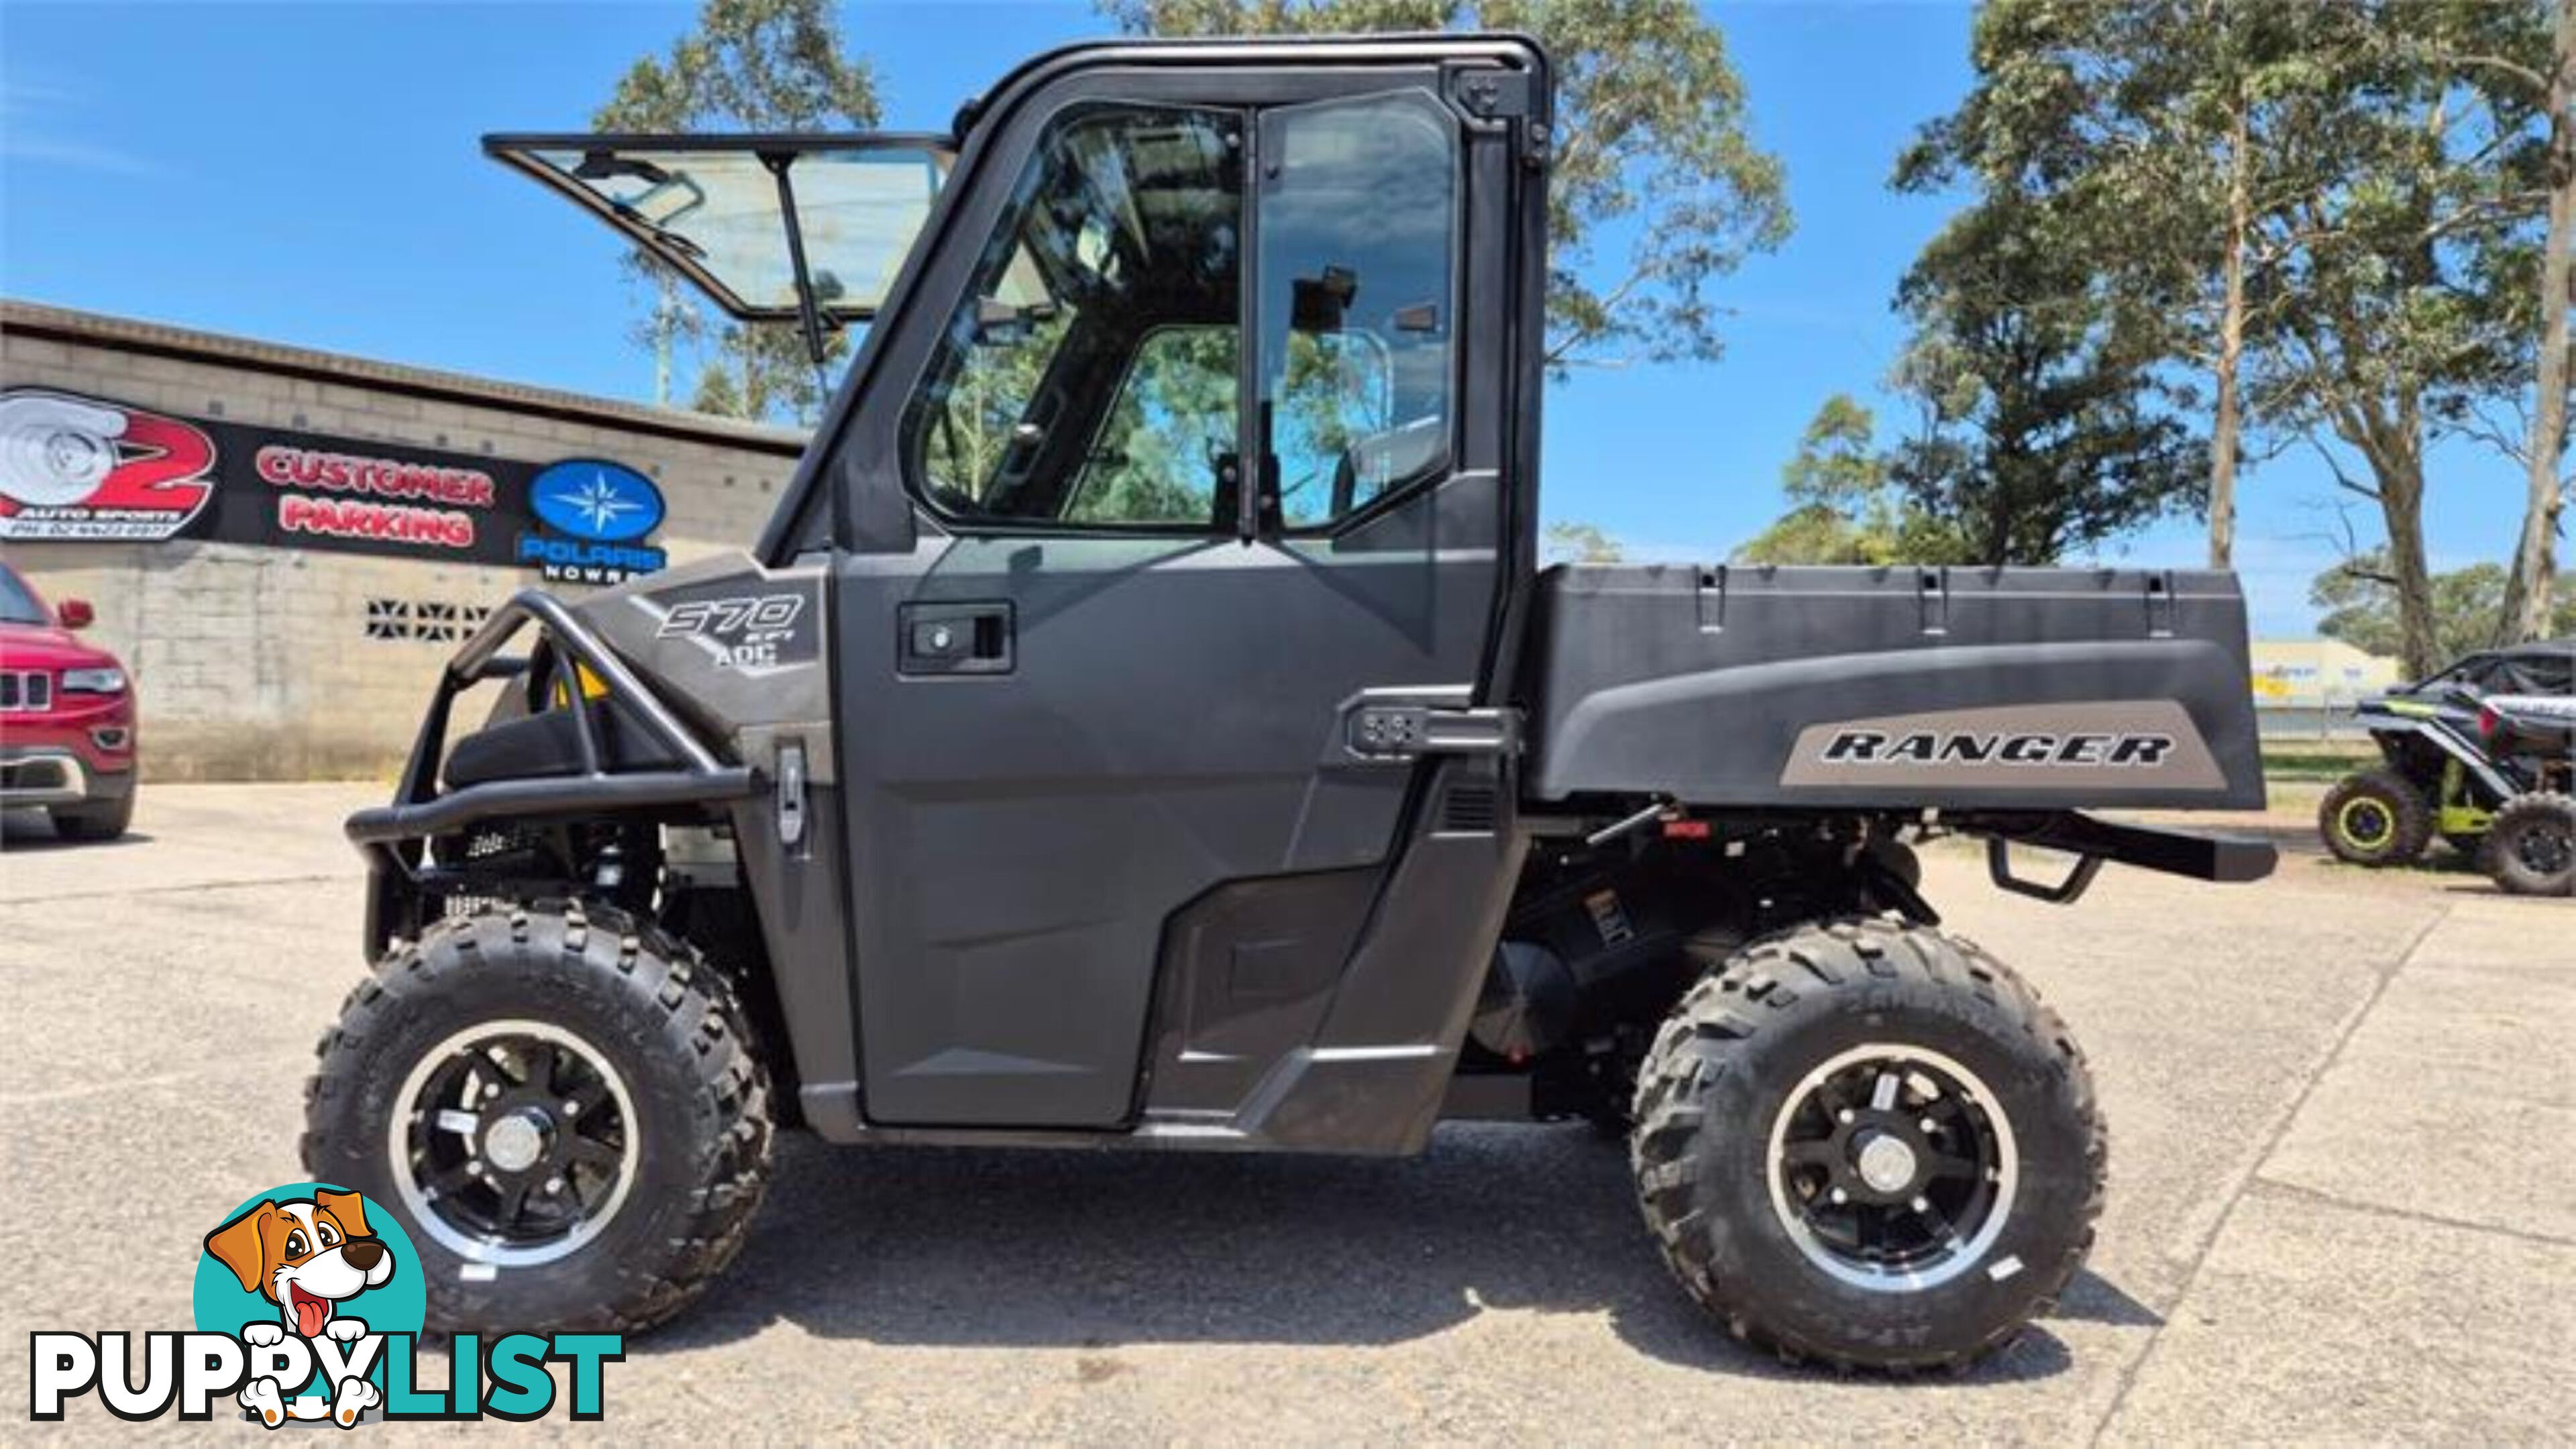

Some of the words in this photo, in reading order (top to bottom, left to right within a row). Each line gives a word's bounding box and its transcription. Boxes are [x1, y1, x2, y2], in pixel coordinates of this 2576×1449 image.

[257, 446, 495, 505] CUSTOMER
[17, 508, 90, 521] AUTO
[95, 510, 181, 523] SPORTS
[279, 494, 474, 546] PARKING
[521, 537, 664, 570] POLARIS
[655, 593, 804, 639] 570
[1821, 731, 2175, 766] RANGER
